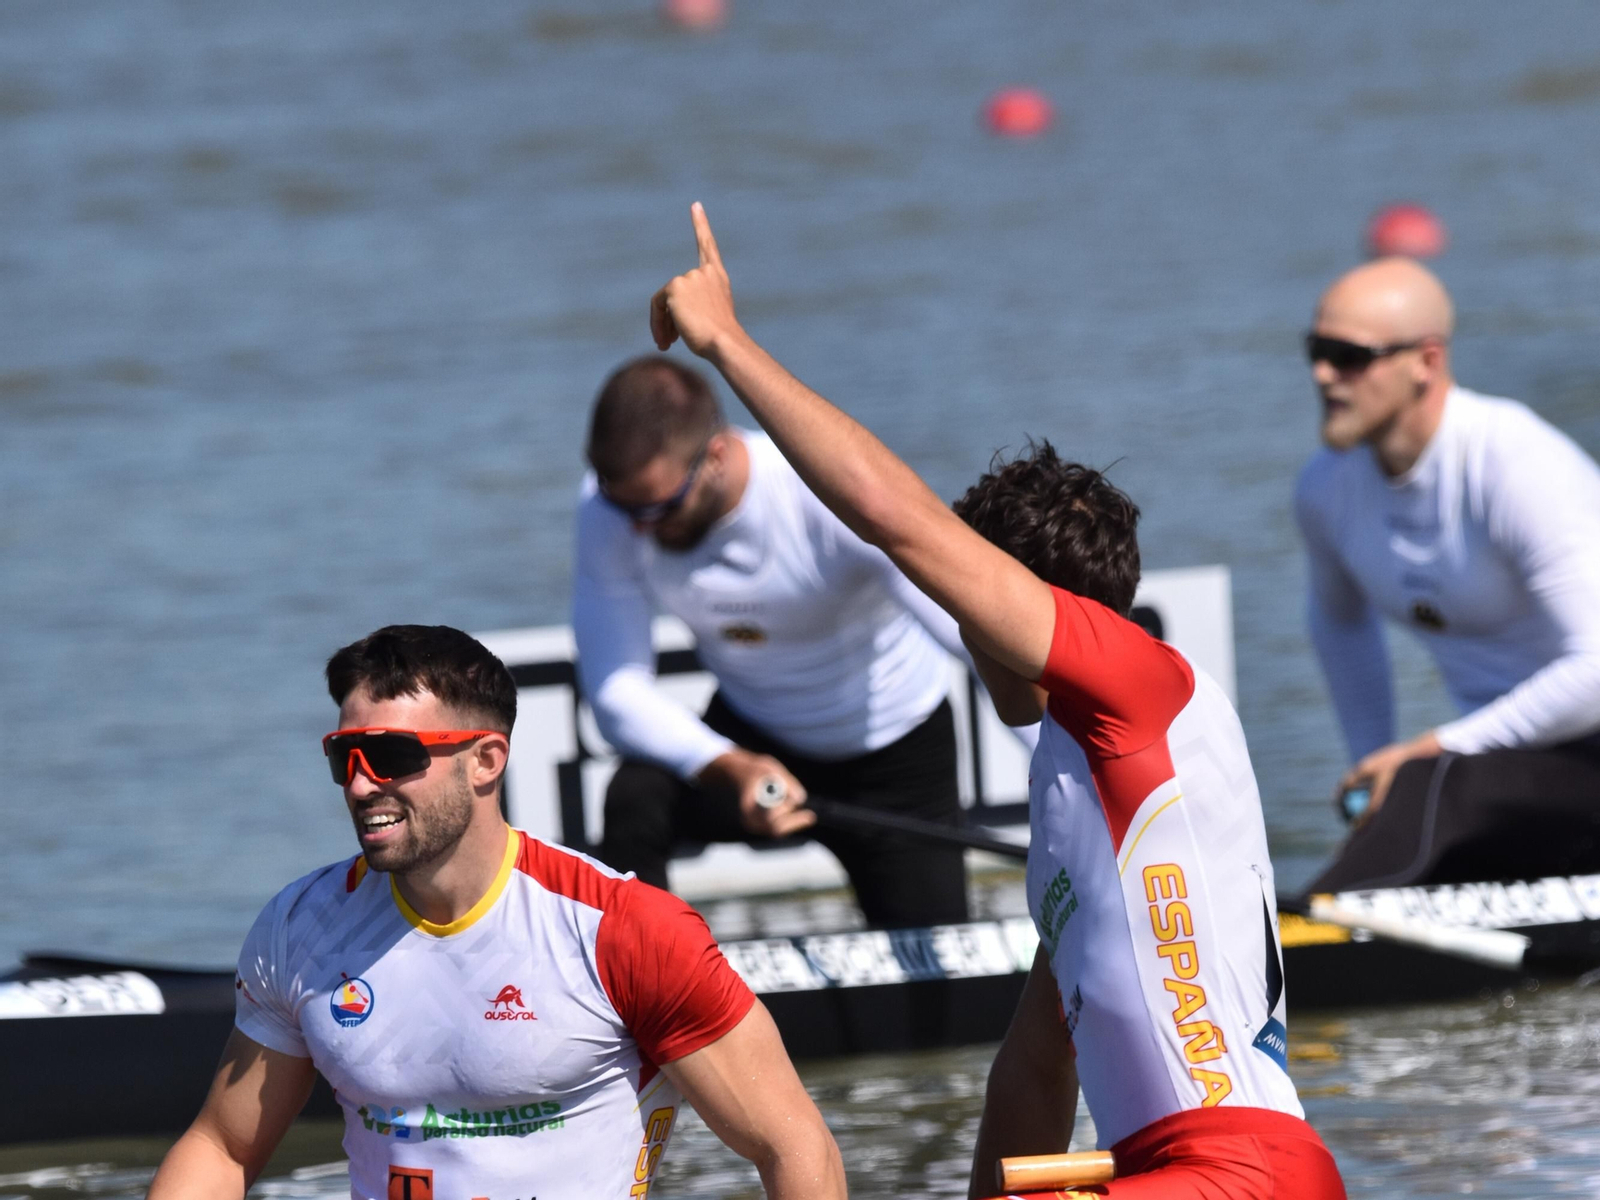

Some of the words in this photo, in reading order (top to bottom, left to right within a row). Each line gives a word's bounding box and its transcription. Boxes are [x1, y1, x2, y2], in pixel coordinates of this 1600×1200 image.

[1142, 863, 1234, 1107] ESPAÑA
[484, 1011, 538, 1022] austral
[421, 1101, 561, 1128] Asturias
